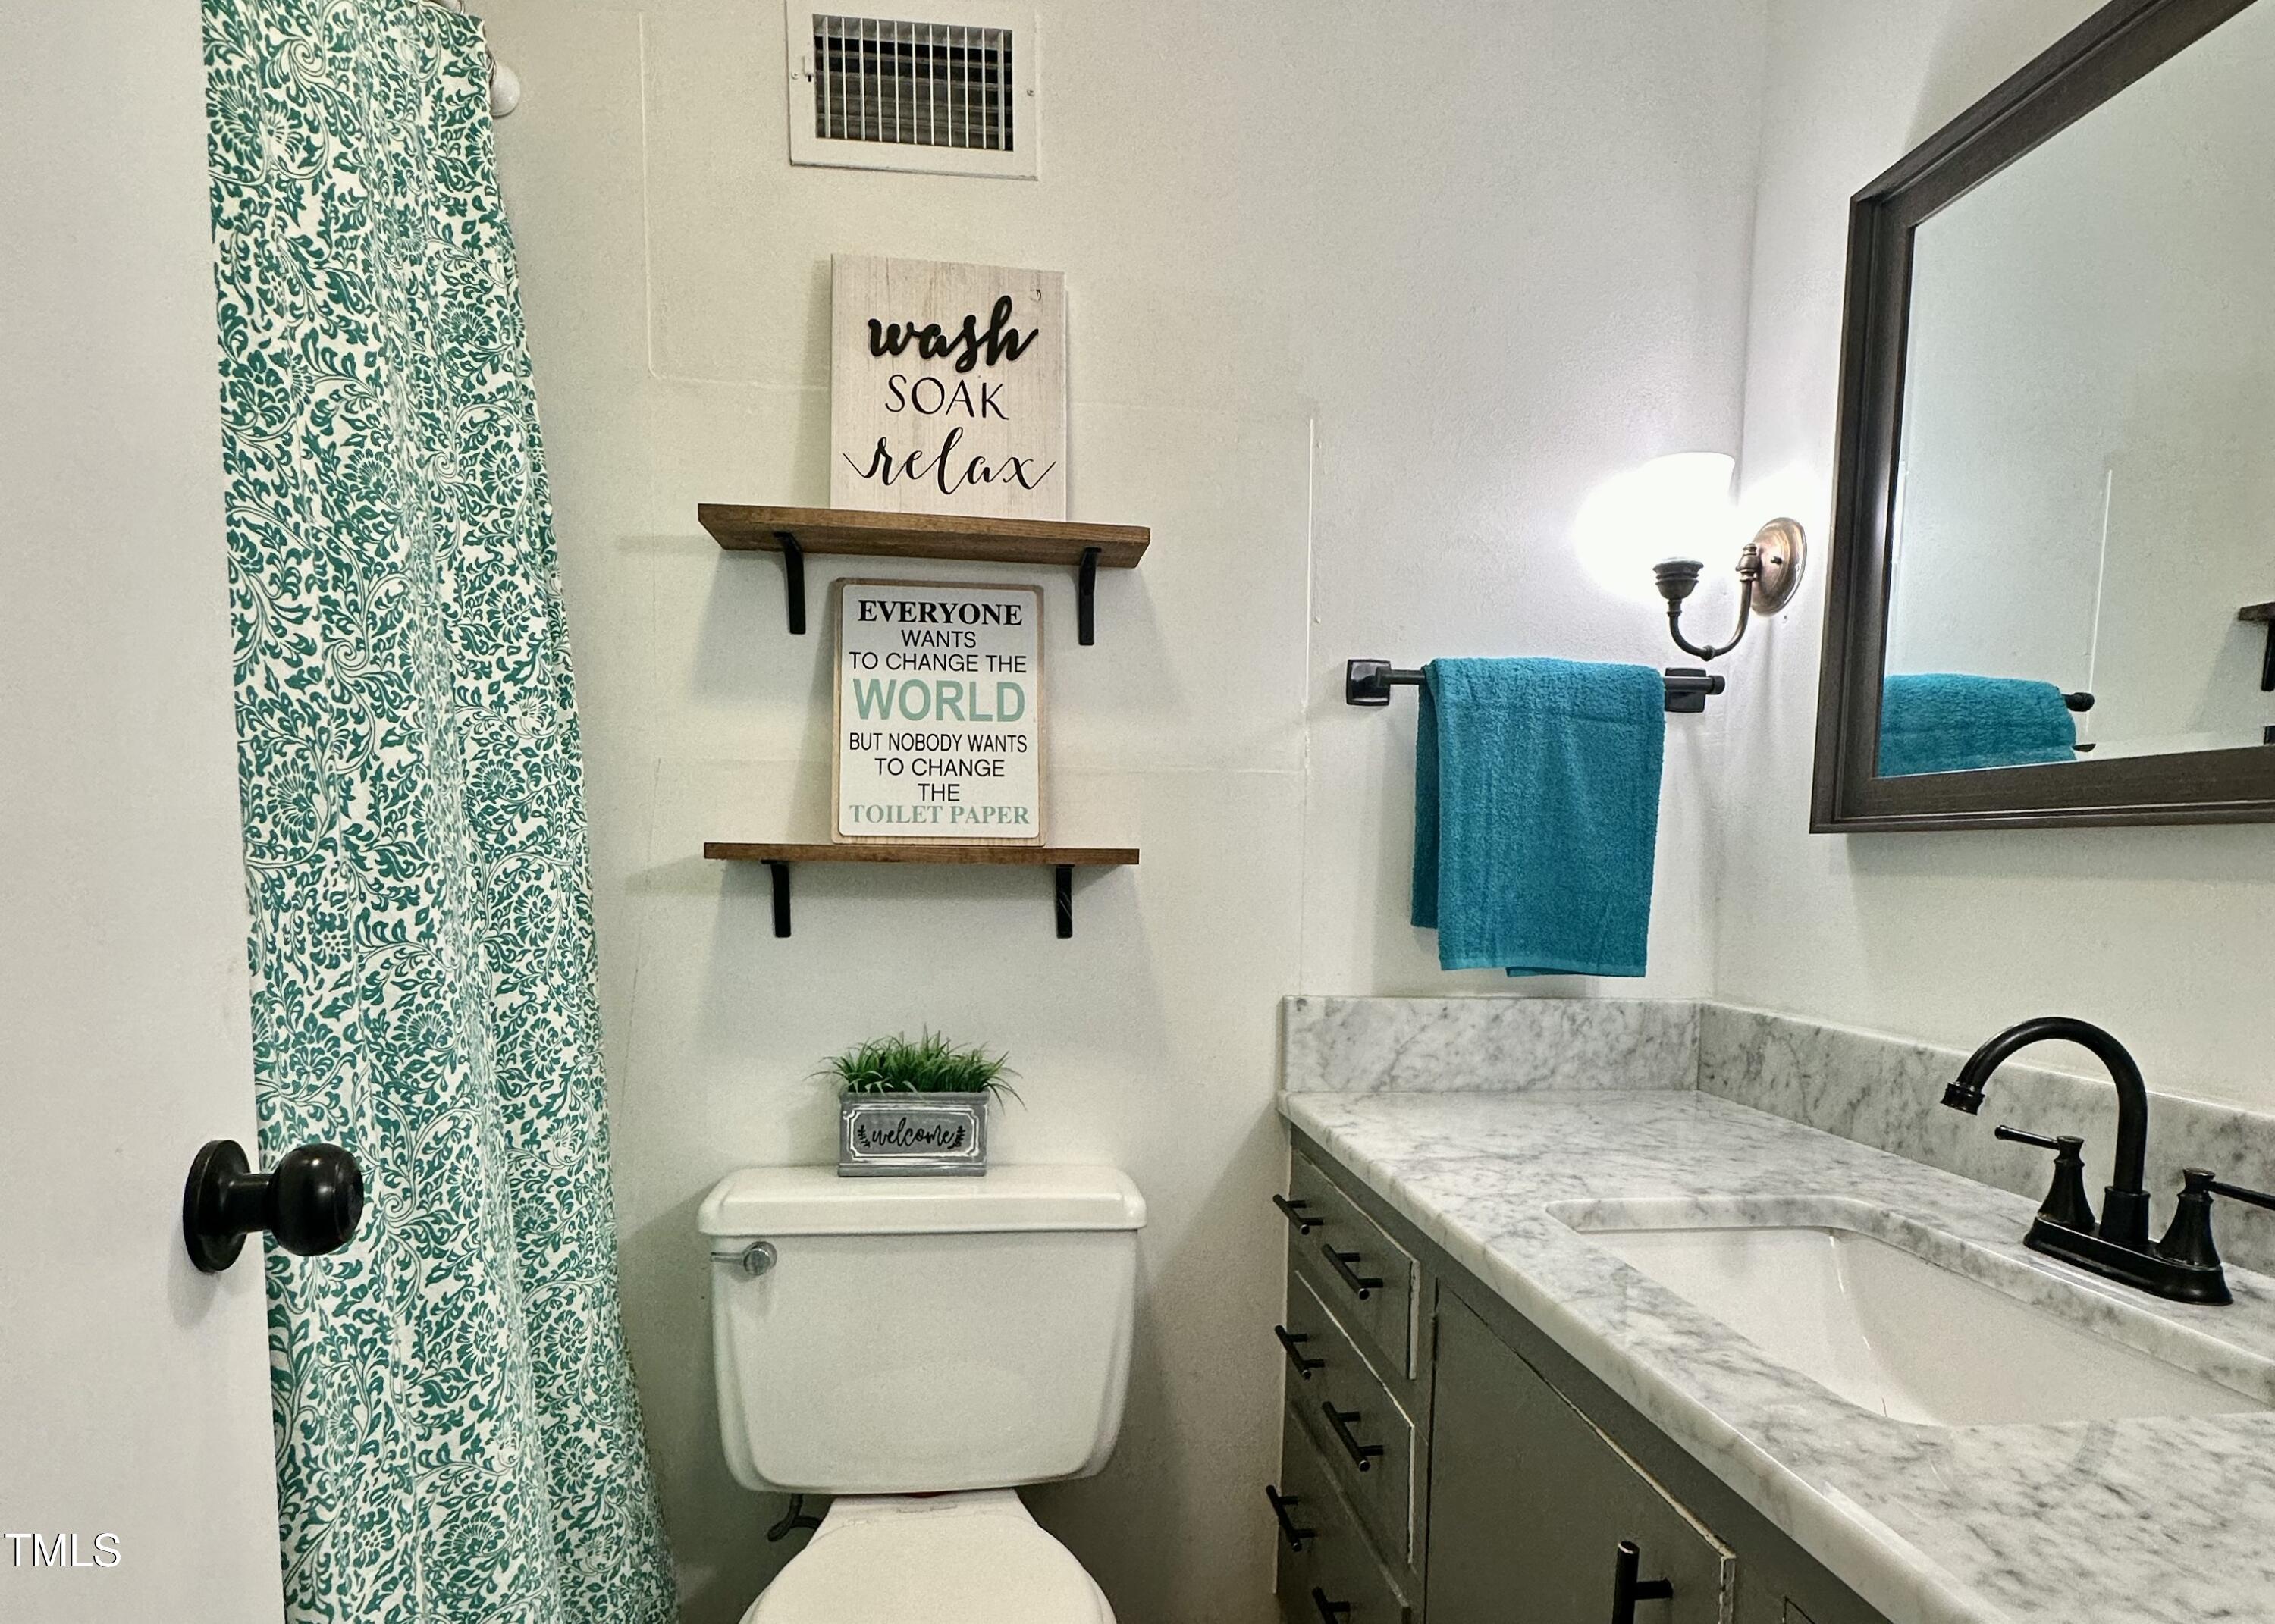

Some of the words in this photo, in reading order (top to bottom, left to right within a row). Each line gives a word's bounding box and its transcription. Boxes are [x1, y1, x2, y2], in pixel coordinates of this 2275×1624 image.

[868, 295, 1039, 373] wash
[885, 374, 1009, 420] SOAK
[843, 427, 1056, 494] relax
[858, 600, 1022, 625] EVERYONE
[902, 630, 976, 648] WANTS
[849, 651, 878, 670] TO
[886, 652, 978, 672] CHANGE
[985, 655, 1027, 672] THE
[853, 678, 1025, 722] WORLD
[849, 732, 883, 751] BUT
[889, 733, 962, 752] NOBODY
[968, 734, 1027, 753] WANTS
[874, 758, 904, 776] TO
[912, 758, 1005, 777] CHANGE
[918, 783, 960, 801] THE
[849, 804, 943, 824] TOILET
[951, 806, 1030, 825] PAPER
[872, 1117, 956, 1148] welcome
